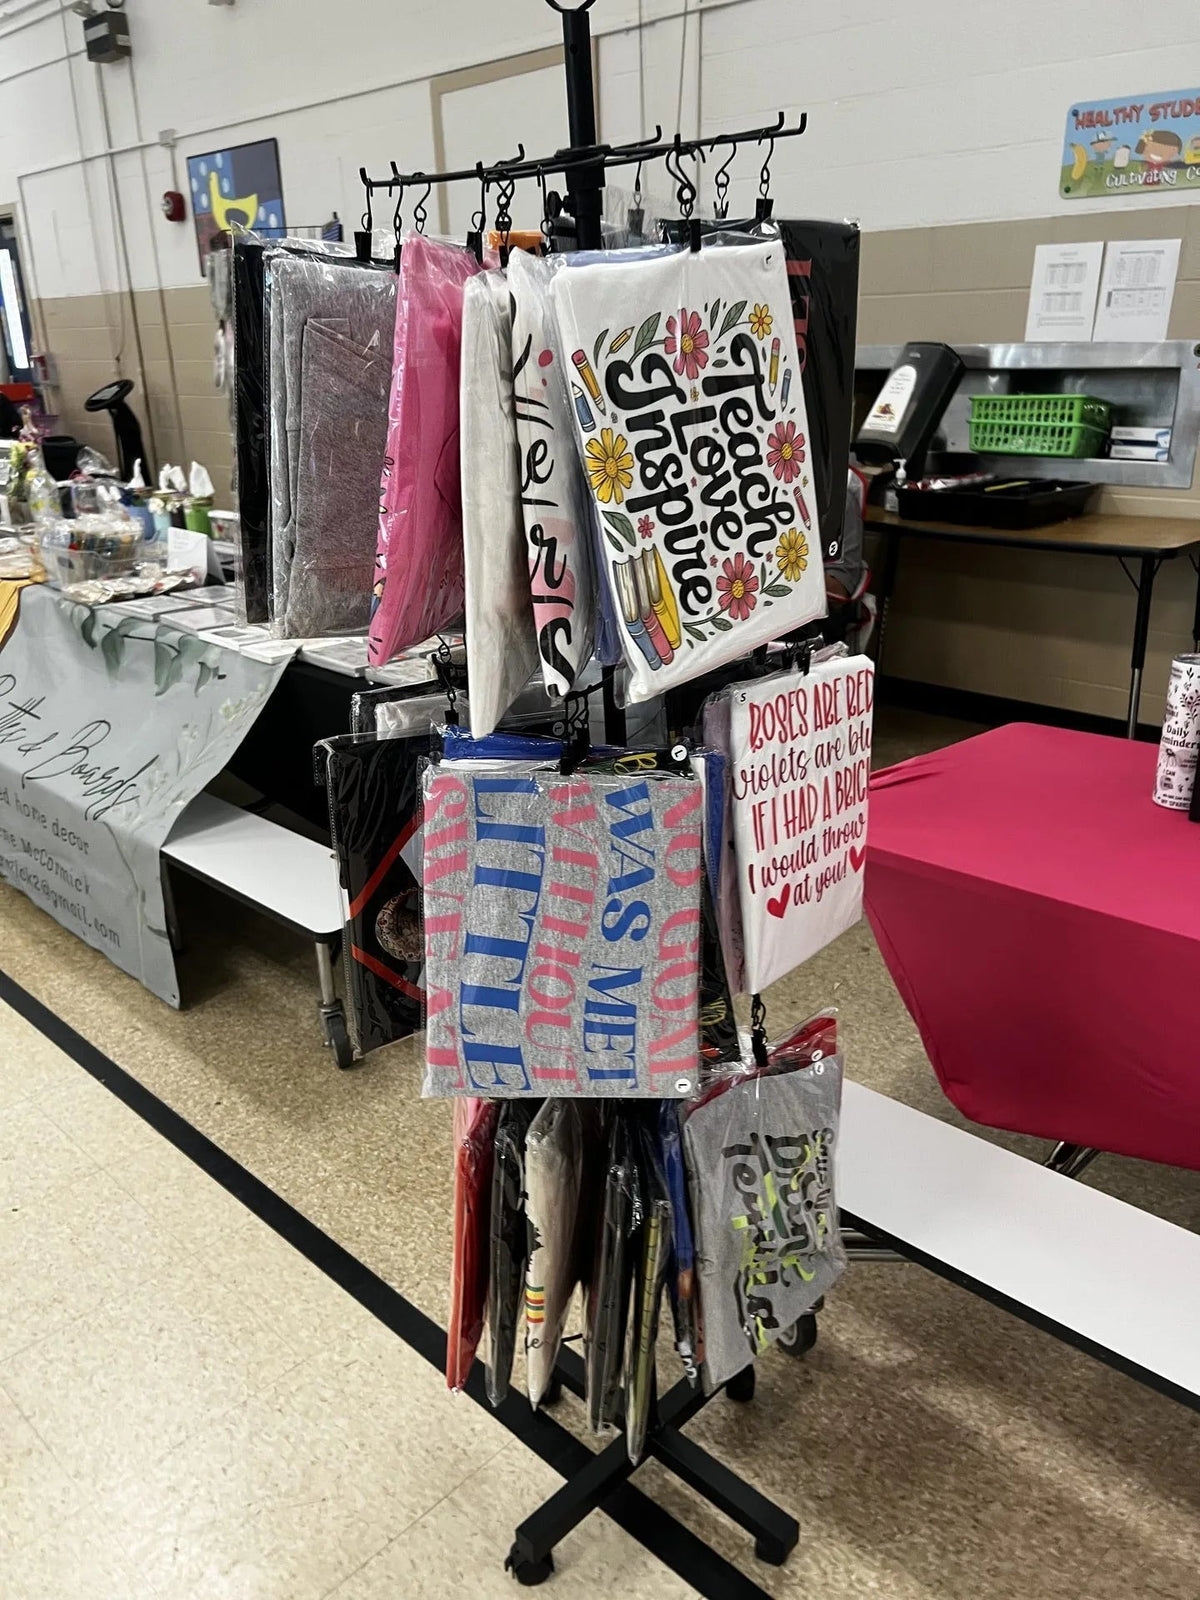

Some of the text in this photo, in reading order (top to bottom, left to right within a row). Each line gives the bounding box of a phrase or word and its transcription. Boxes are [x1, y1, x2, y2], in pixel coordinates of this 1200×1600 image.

[1075, 104, 1144, 130] HEALTHY
[605, 353, 712, 617] Inspire
[670, 405, 743, 551] Love
[701, 332, 796, 558] Teach
[748, 687, 809, 753] ROSES
[813, 677, 843, 732] ARE
[1166, 724, 1190, 739] Daily
[22, 720, 160, 821] Boards
[732, 748, 811, 801] violets
[814, 737, 845, 770] are
[752, 756, 870, 853] IF I HAD A BRIC
[14, 792, 47, 829] home
[52, 817, 90, 855] decor
[20, 837, 91, 895] McCormick
[600, 780, 655, 942] WAS
[748, 812, 865, 894] I would throw
[793, 850, 848, 906] at you!
[423, 774, 469, 1090] SWEAT
[460, 775, 546, 1091] LITTLE
[525, 779, 599, 1093] WITHOUT
[648, 783, 701, 1092] NO GOAL
[583, 962, 644, 1090] MET
